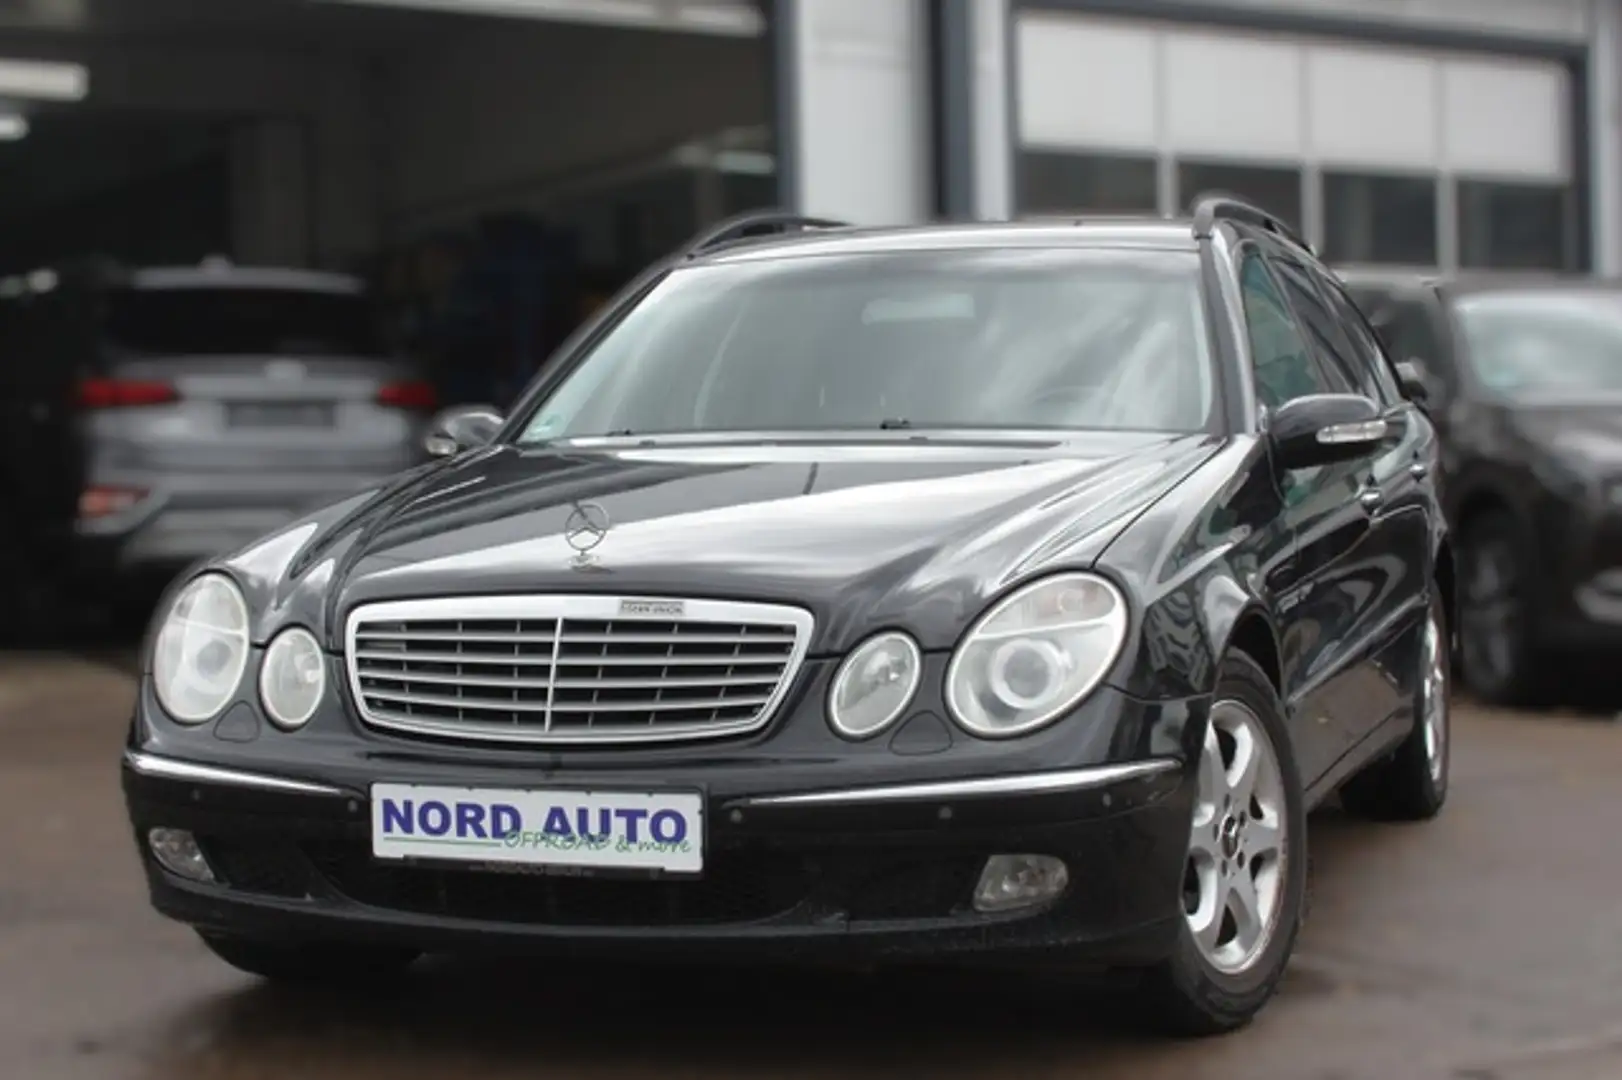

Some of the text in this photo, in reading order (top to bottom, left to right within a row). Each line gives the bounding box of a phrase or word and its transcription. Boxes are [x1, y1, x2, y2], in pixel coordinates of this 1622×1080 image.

[382, 799, 687, 844] NORD AUTO
[615, 834, 632, 853] &
[638, 839, 692, 853] more
